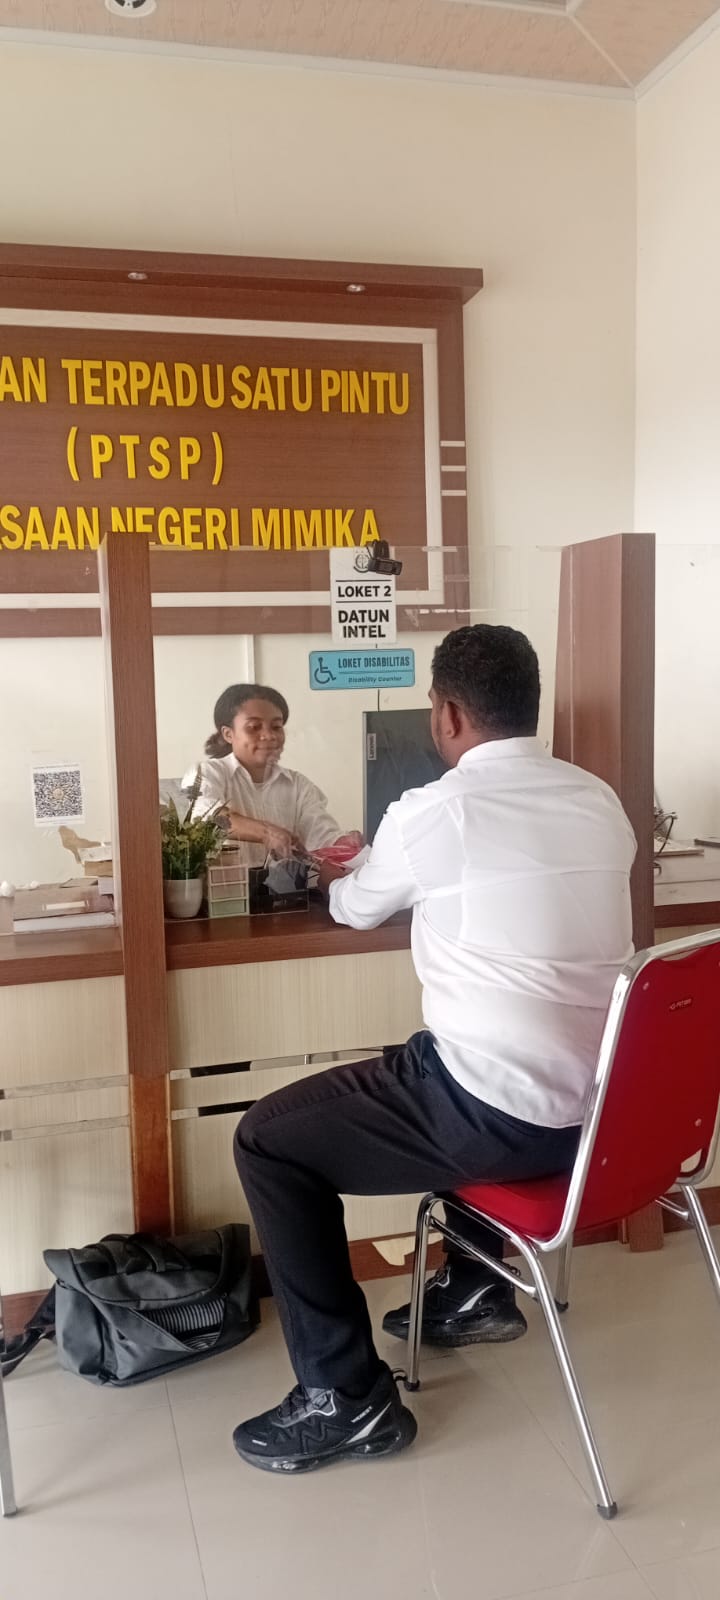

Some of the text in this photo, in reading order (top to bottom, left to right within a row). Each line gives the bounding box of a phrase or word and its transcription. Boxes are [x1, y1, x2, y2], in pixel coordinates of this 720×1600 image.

[0, 356, 409, 415] AN TERPADU SATU PINTU
[0, 504, 100, 551] SAAN
[252, 508, 382, 551] MIMIKA
[338, 585, 391, 598] LOKET 2
[338, 609, 389, 624] DATUN
[343, 625, 386, 639] INTEL
[338, 656, 410, 668] LOKET DISABILITAS
